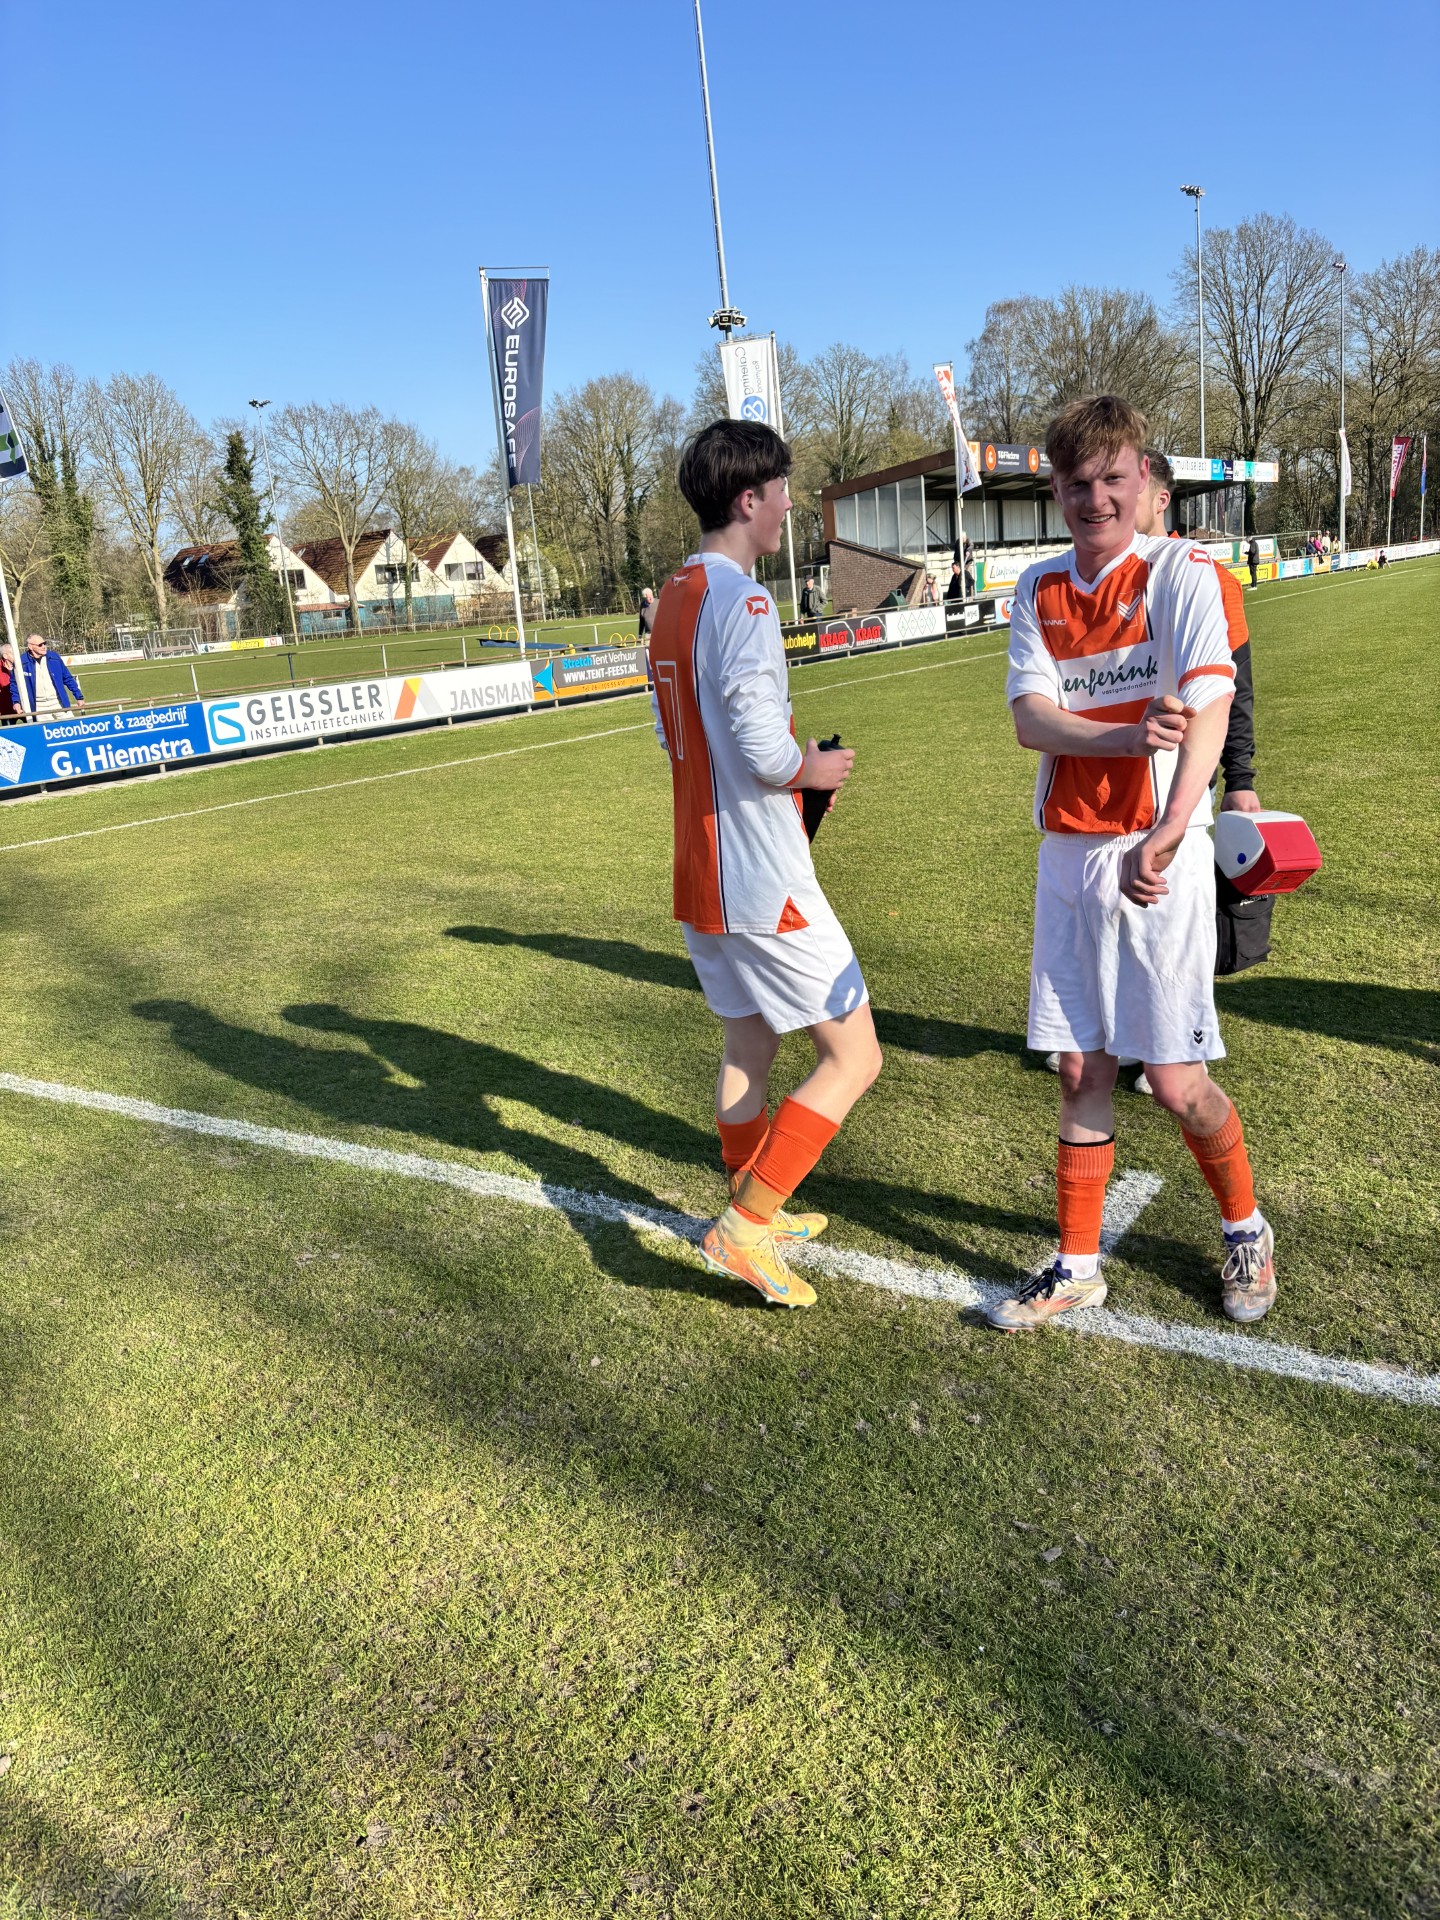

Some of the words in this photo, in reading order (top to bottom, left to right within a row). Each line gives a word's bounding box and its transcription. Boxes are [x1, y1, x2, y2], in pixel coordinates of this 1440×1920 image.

[503, 334, 520, 469] EUROSAFE
[820, 630, 848, 647] KRAGT
[855, 625, 881, 640] KRAGT
[608, 650, 637, 663] Verhuur
[563, 663, 639, 683] WWW.TENT-FEEST.NL
[1064, 655, 1158, 697] enferink
[246, 684, 382, 726] GEISSLER
[450, 680, 533, 712] JANSMAN
[43, 719, 111, 740] betonboor
[114, 714, 125, 730] &
[126, 706, 187, 729] zaagbedrijf
[250, 710, 385, 741] INSTALLATIETECHNIEK
[51, 750, 82, 777] G.
[86, 737, 195, 772] Hiemstra
